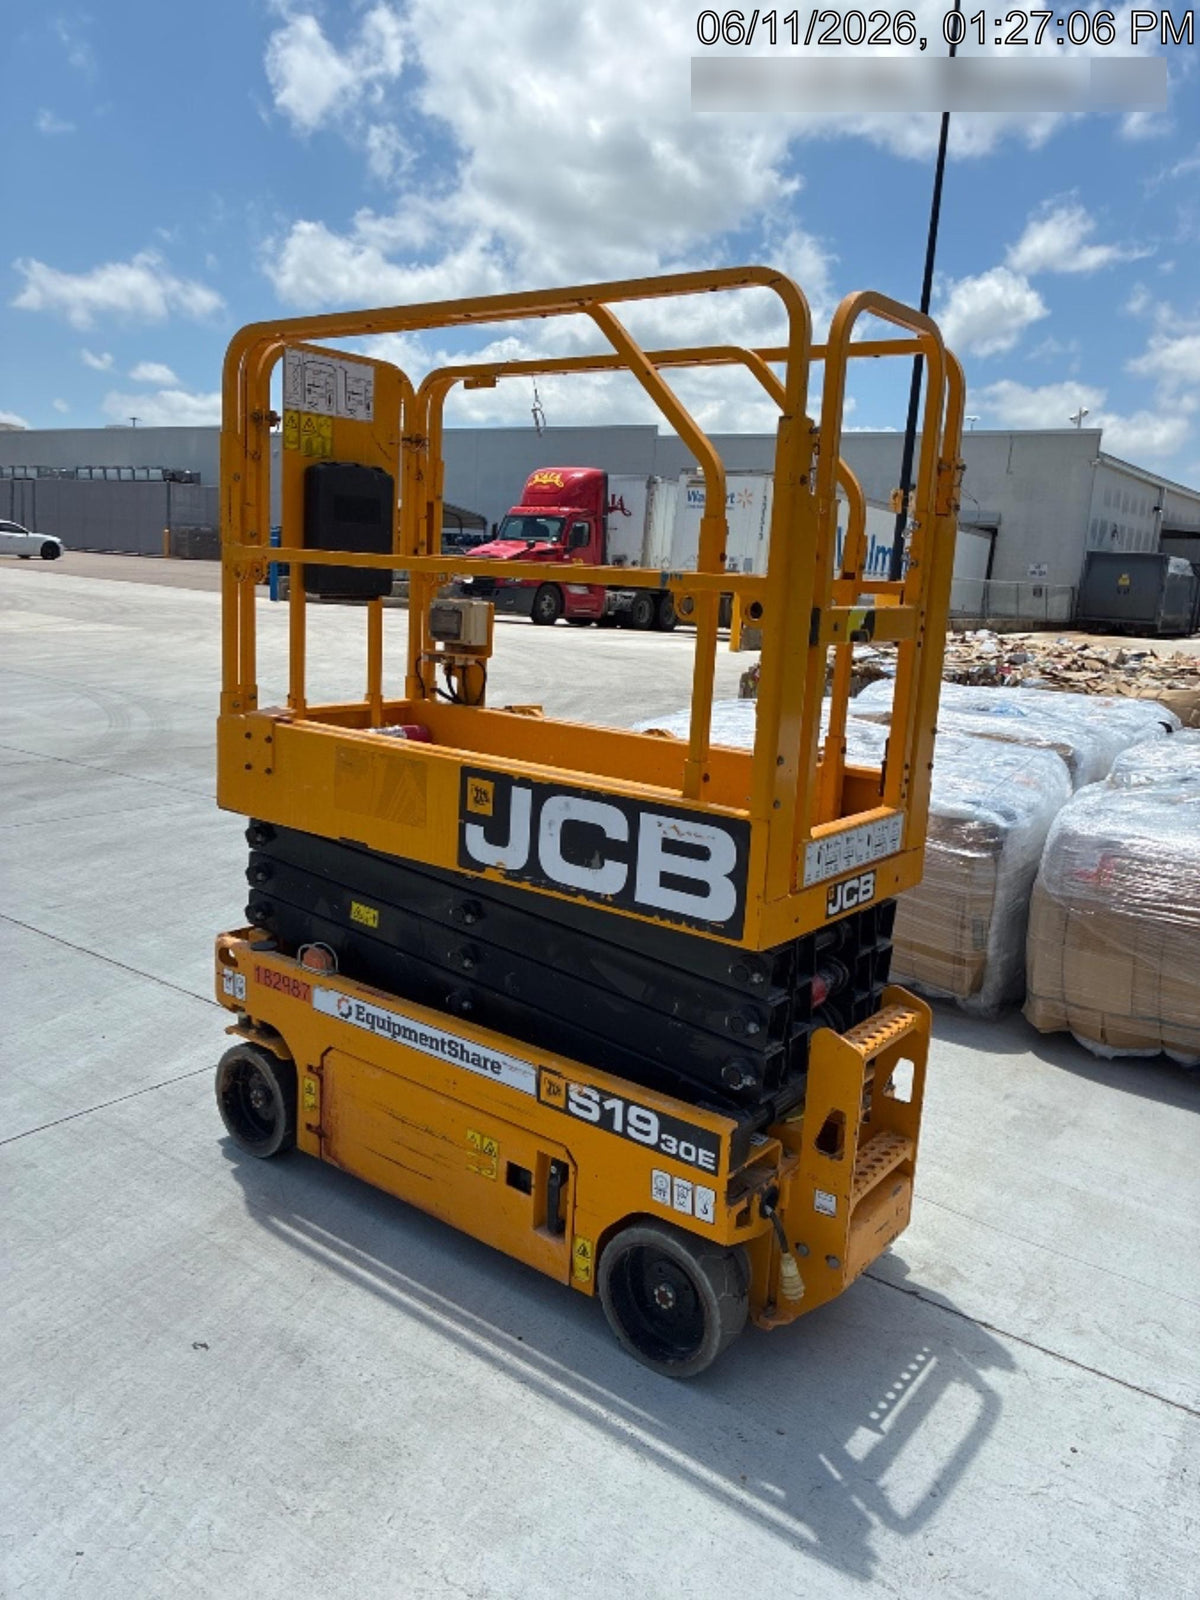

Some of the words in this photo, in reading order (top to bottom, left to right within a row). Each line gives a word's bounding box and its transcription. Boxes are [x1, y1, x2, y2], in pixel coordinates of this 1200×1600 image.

[465, 785, 738, 922] JCB
[828, 872, 875, 915] JCB
[355, 1004, 503, 1076] EquipmentShare
